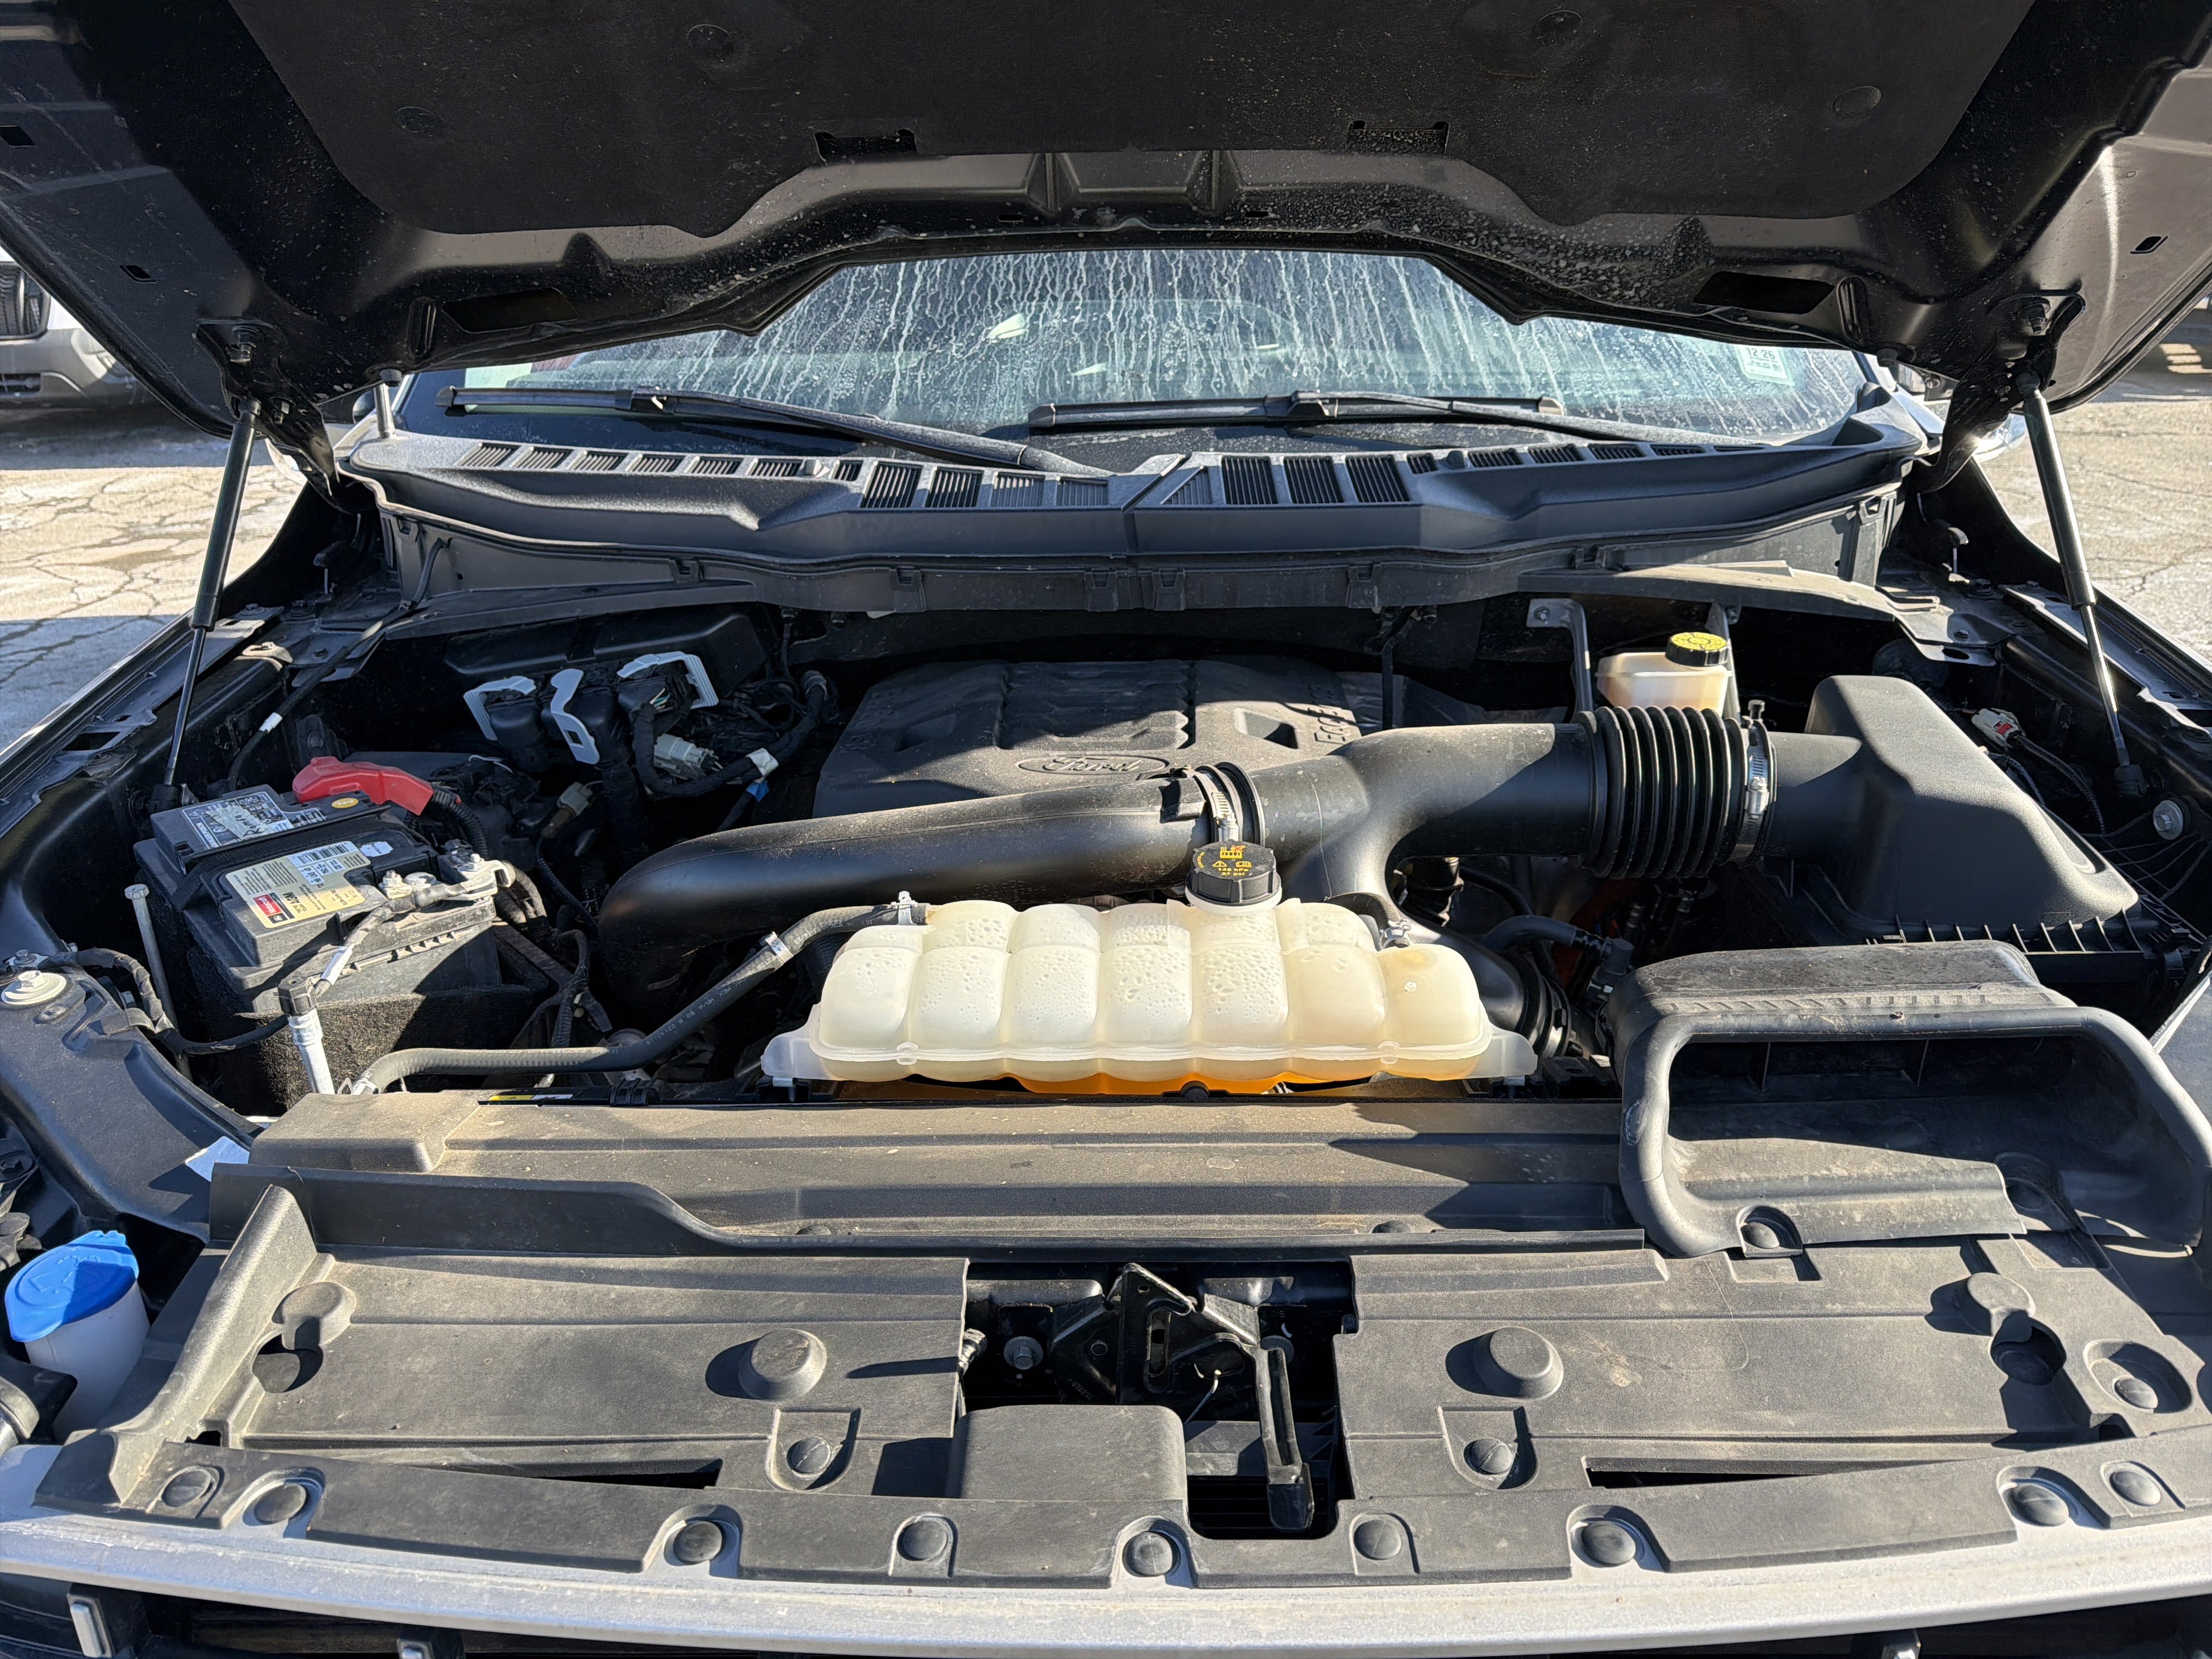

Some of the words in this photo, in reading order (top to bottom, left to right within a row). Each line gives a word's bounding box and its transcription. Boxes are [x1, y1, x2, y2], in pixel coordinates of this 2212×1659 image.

[1042, 757, 1143, 772] Ford
[282, 891, 301, 905] AGM
[718, 986, 732, 997] MEX
